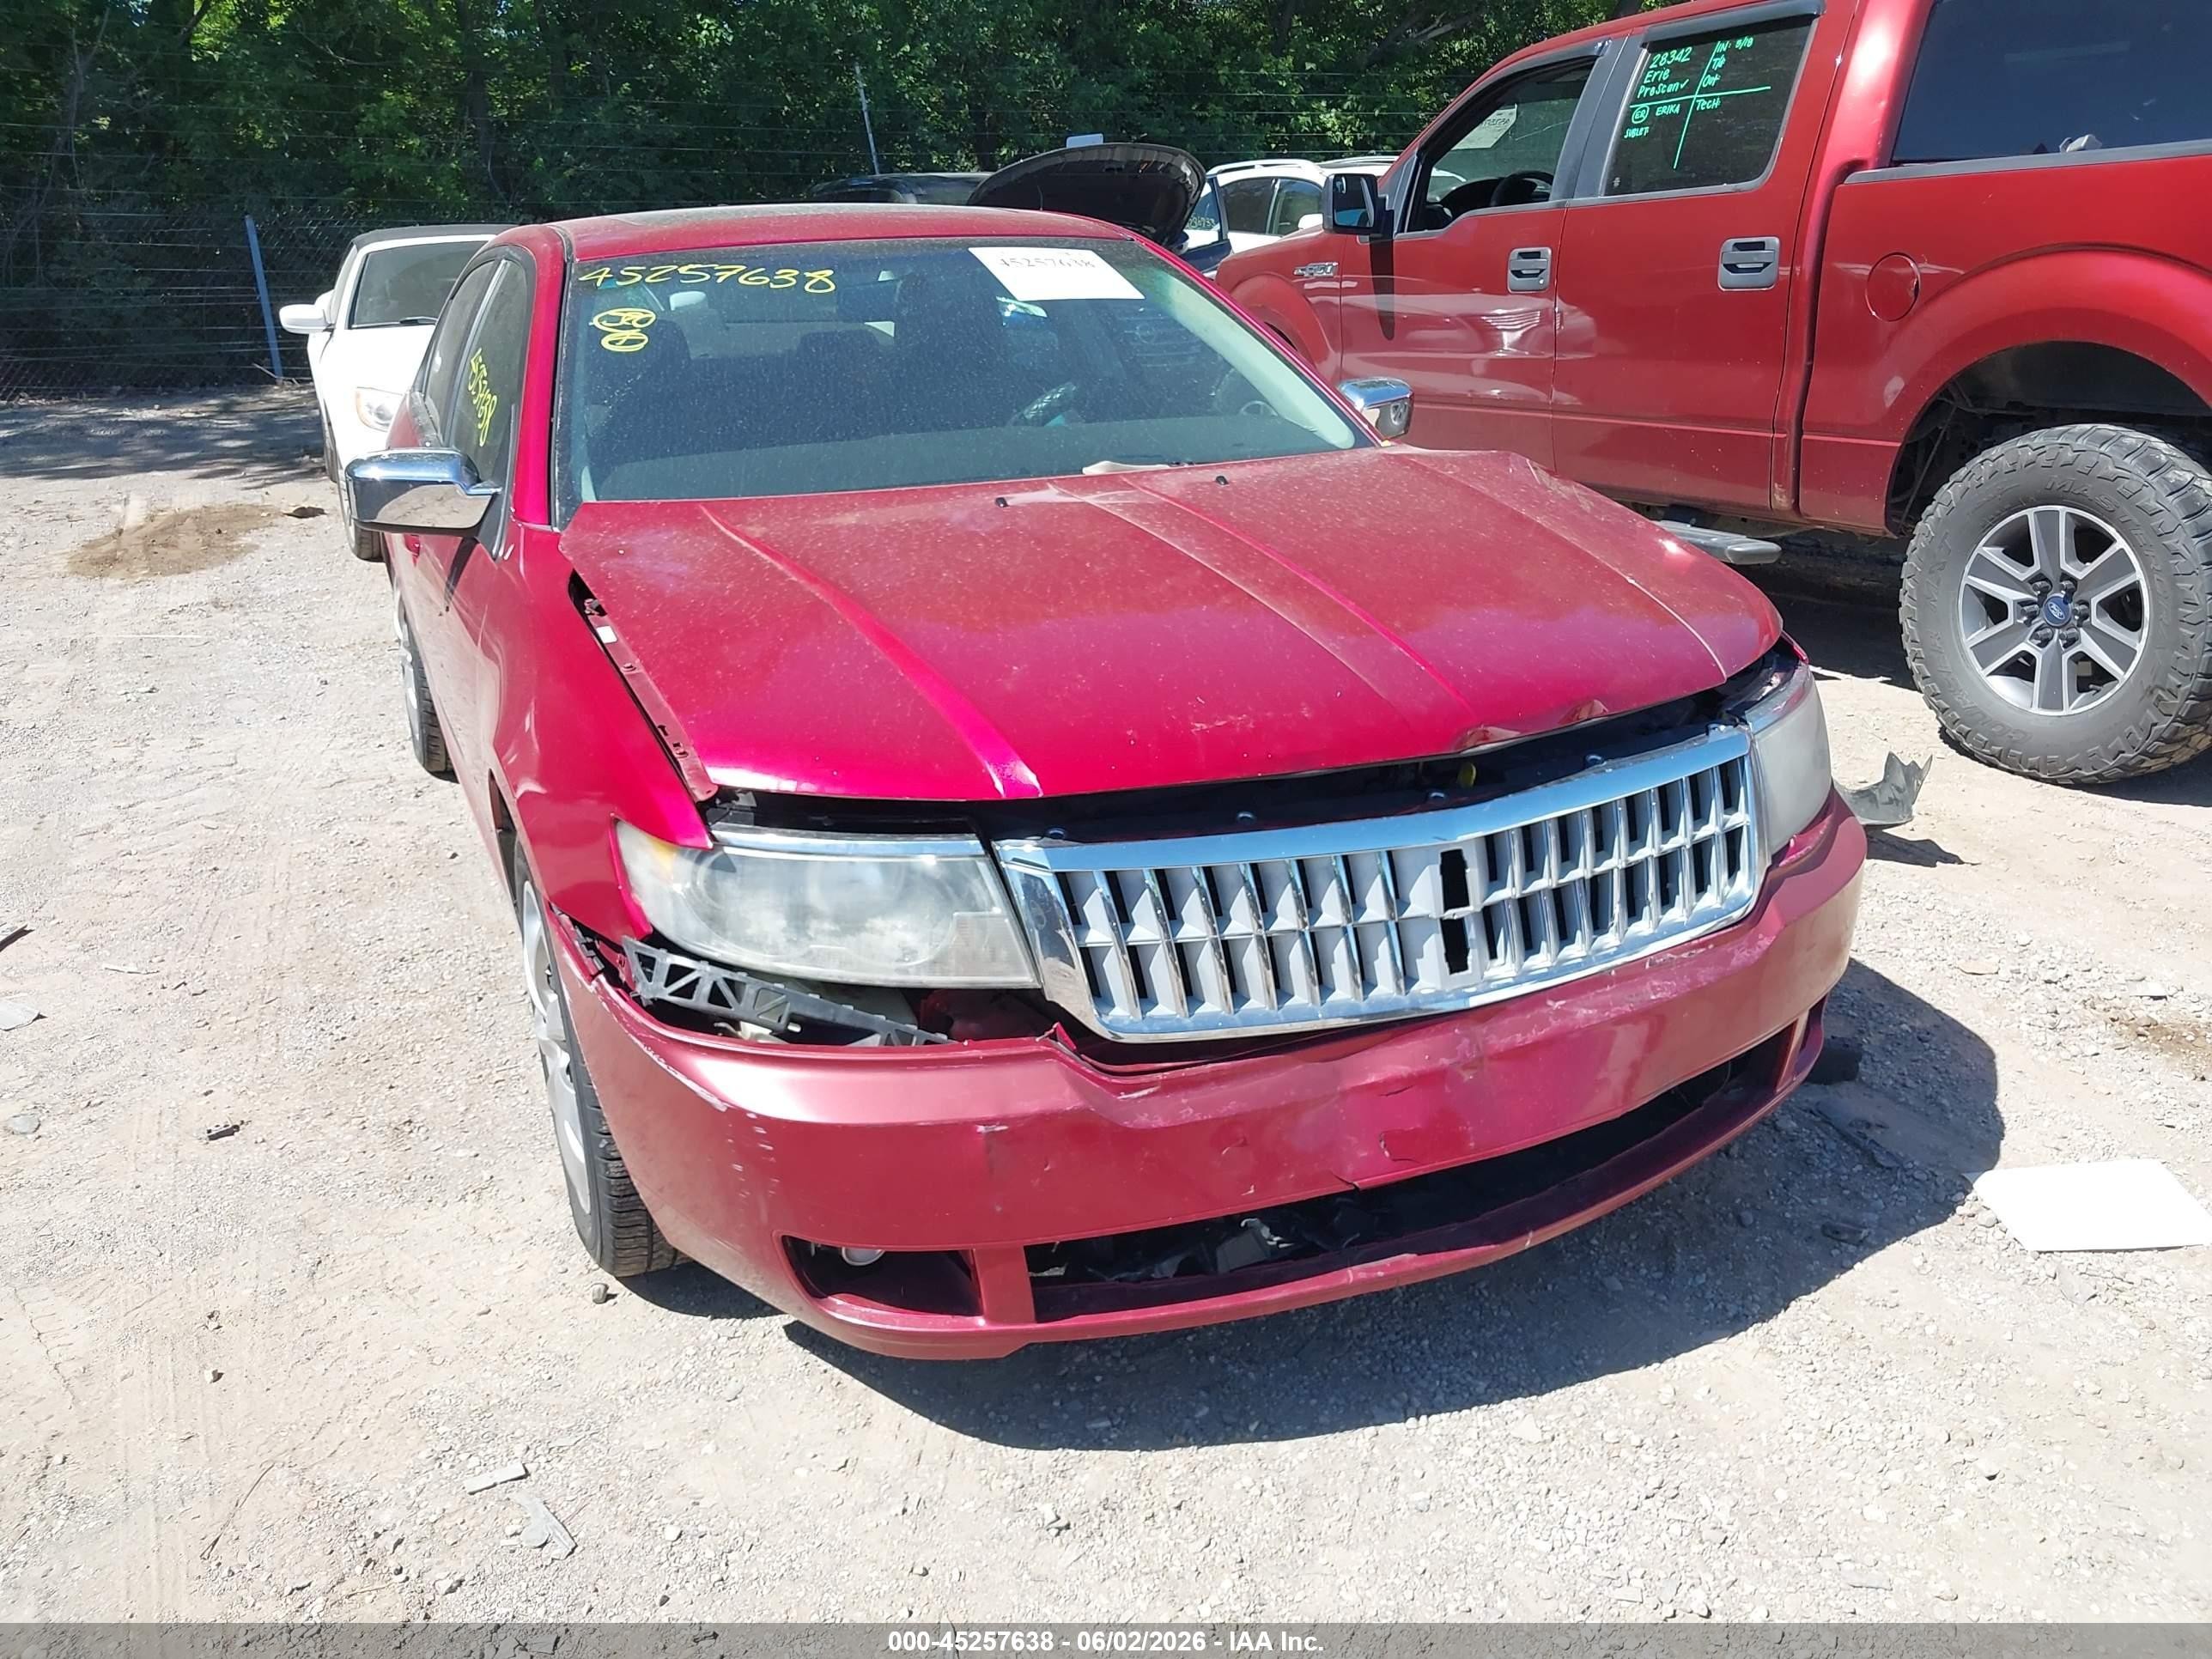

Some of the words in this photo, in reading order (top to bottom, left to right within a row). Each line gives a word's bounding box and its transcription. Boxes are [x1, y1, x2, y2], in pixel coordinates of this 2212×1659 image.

[1649, 46, 1692, 69] 28342
[1644, 67, 1670, 84] Erie
[1656, 103, 1680, 116] ERIKA
[578, 263, 836, 295] 45257638
